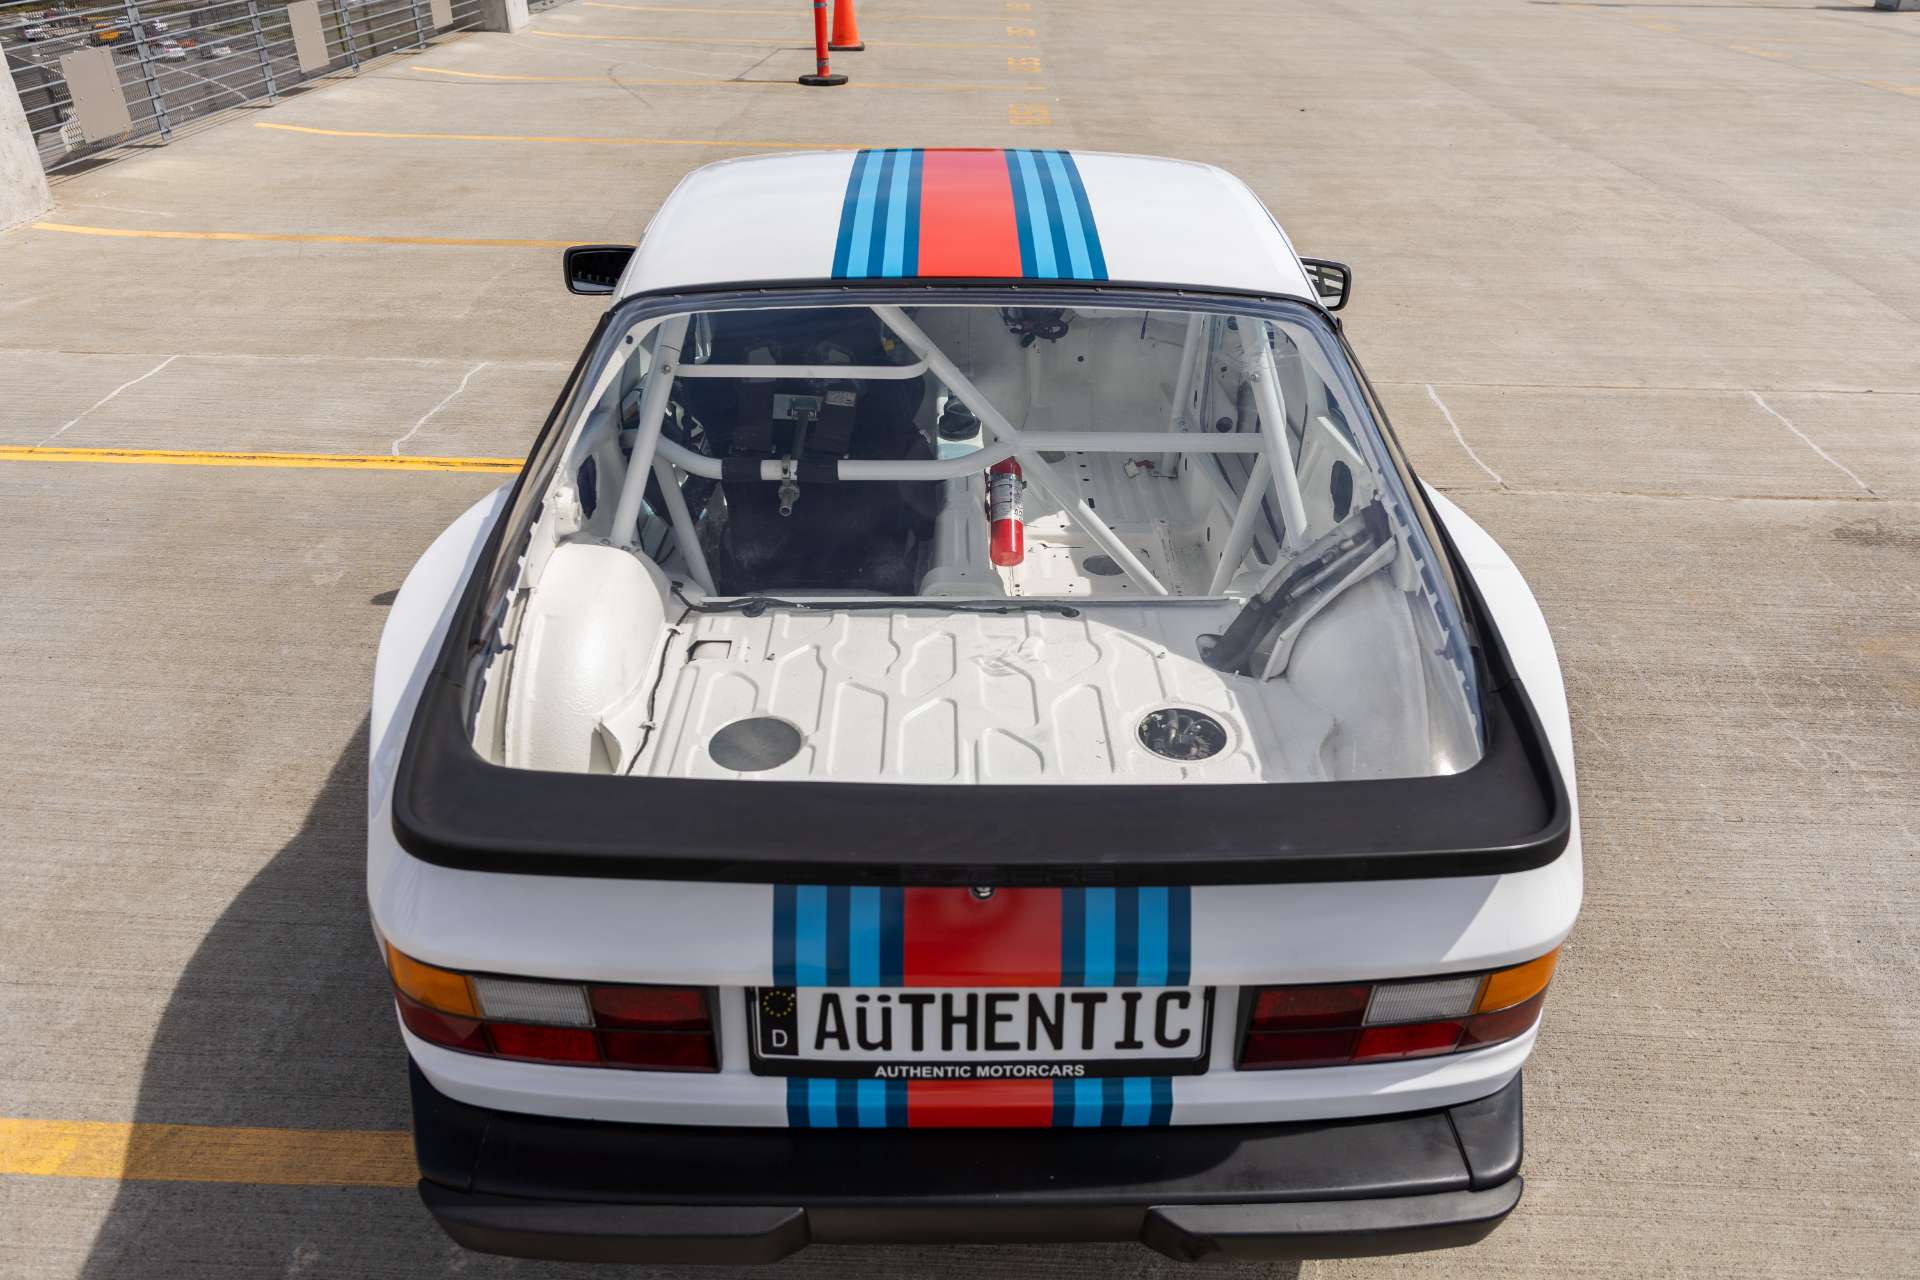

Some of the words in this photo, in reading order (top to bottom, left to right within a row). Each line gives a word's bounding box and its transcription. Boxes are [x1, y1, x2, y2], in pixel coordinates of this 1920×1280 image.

[814, 992, 1192, 1052] AüTHENTIC
[772, 1029, 788, 1047] D
[875, 1065, 971, 1078] AUTHENTIC
[976, 1064, 1085, 1077] MOTORCARS
